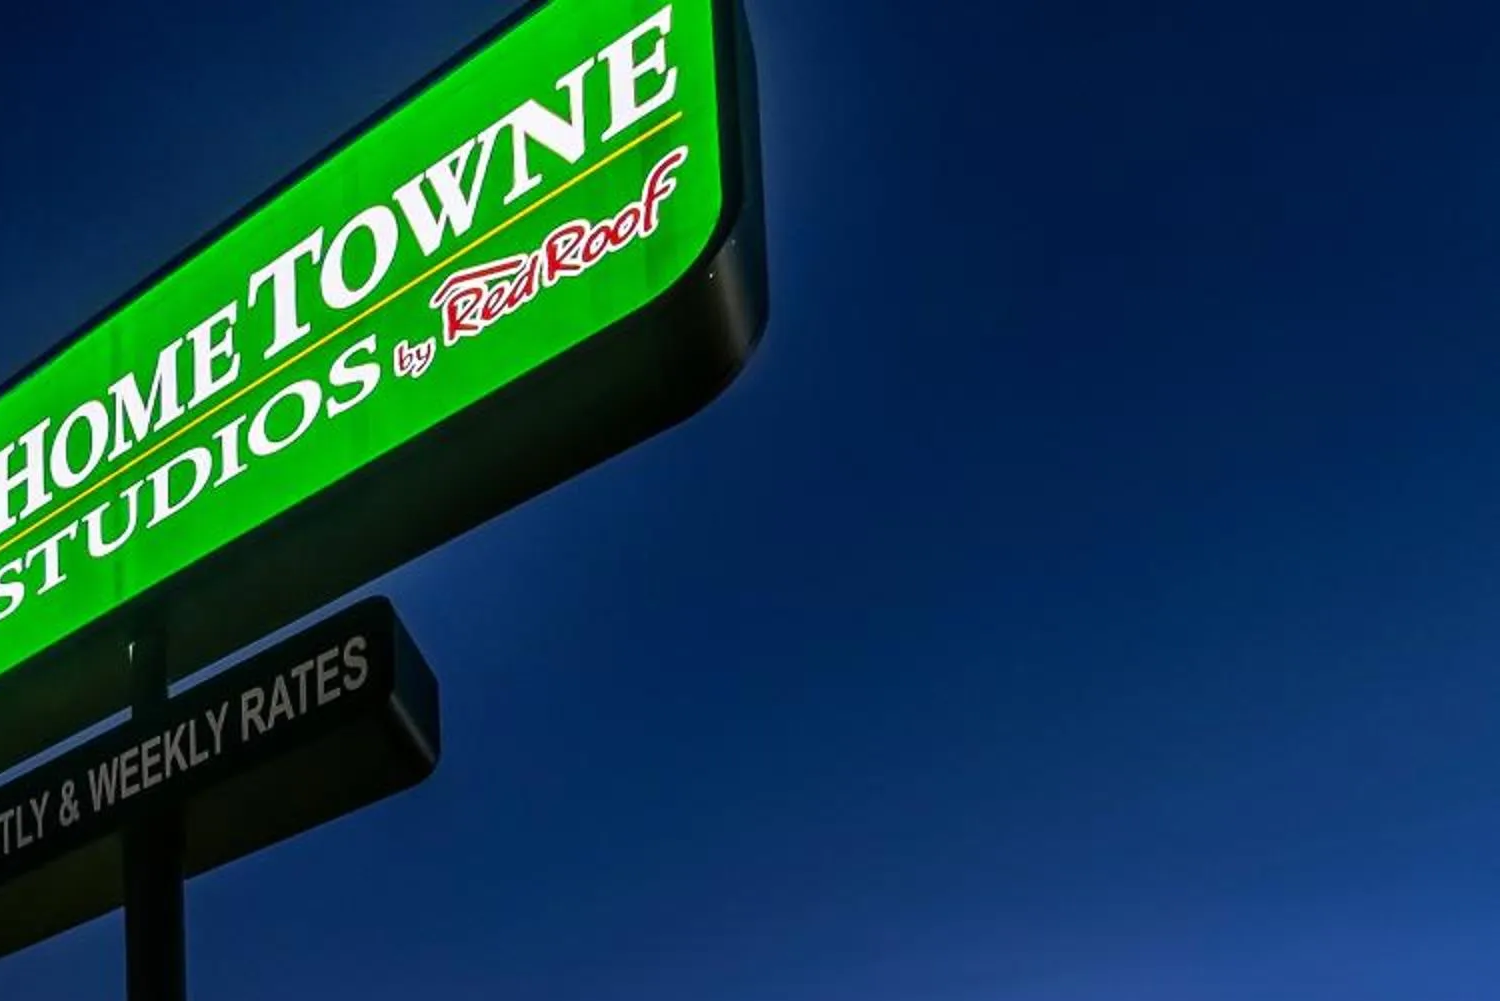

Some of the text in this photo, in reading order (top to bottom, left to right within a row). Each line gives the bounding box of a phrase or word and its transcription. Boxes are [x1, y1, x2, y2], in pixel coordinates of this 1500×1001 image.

[394, 337, 436, 378] by
[59, 779, 80, 826] &
[88, 702, 229, 811] WEEKLY
[241, 636, 368, 741] RATES
